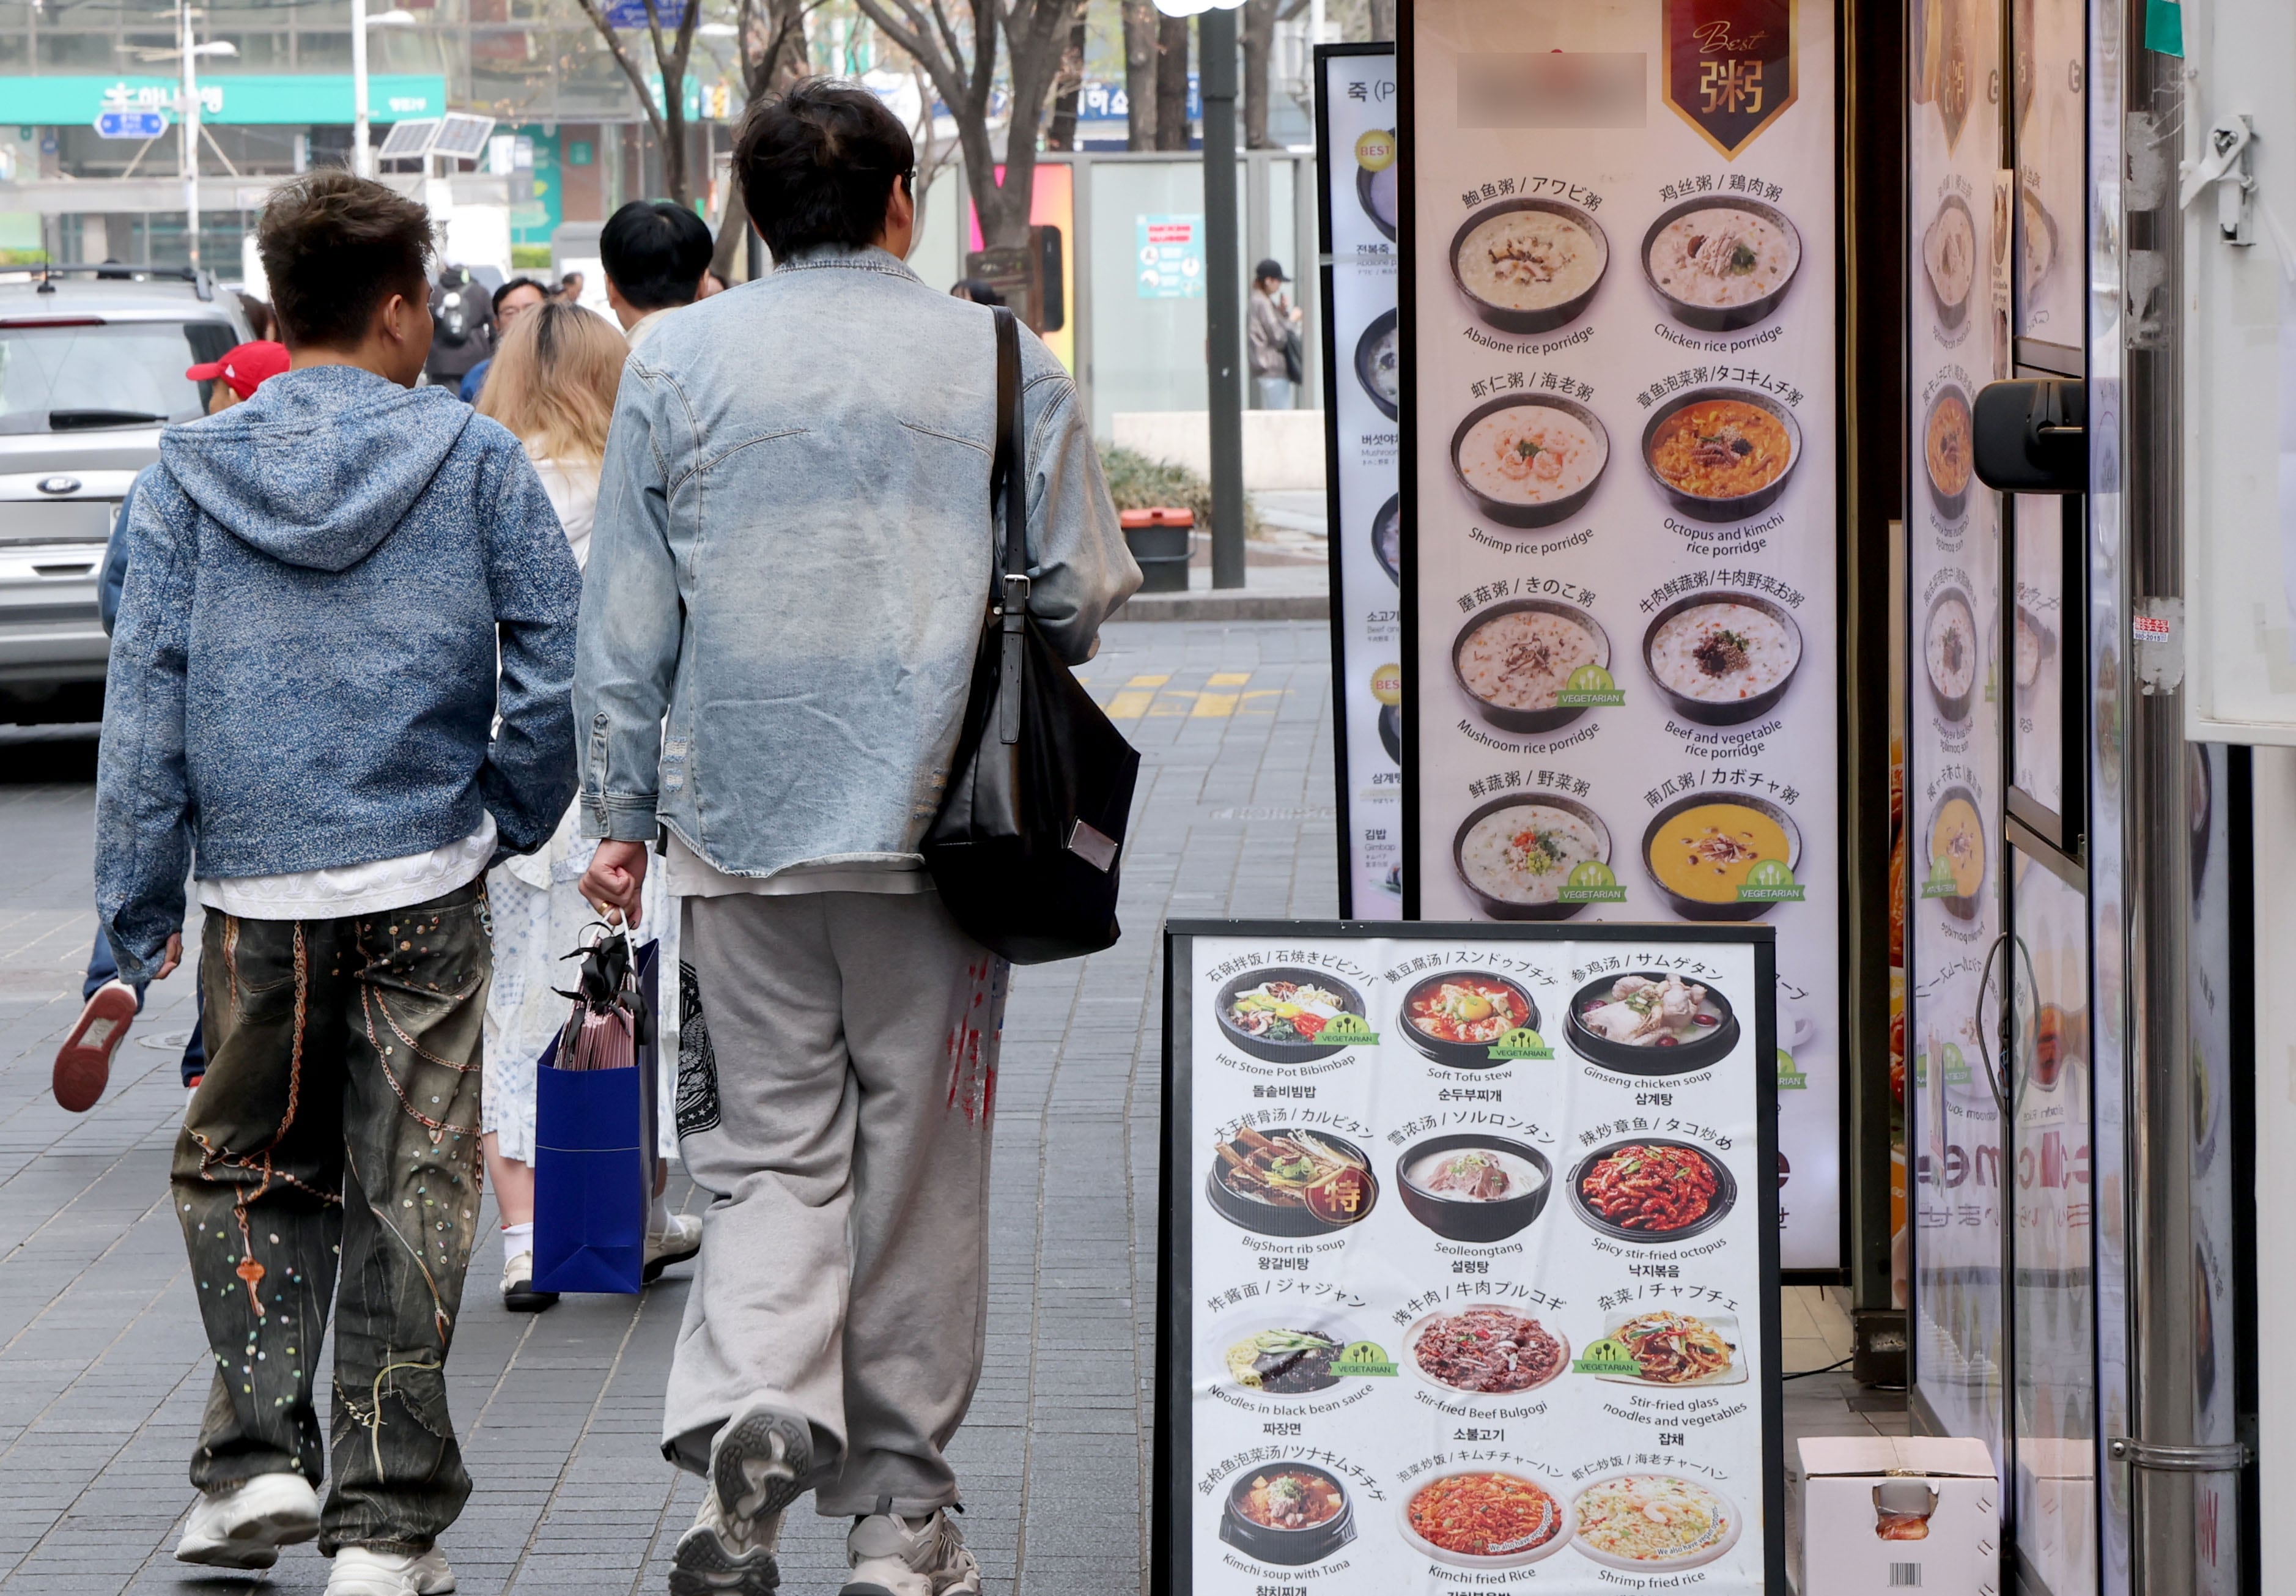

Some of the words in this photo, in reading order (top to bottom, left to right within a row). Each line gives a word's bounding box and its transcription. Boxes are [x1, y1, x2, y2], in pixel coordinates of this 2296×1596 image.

[1692, 21, 1769, 53] Best
[1348, 81, 1367, 102] 죽
[1700, 59, 1762, 113] 粥
[1360, 146, 1391, 156] BEST
[1532, 177, 1602, 211] アワビ粥
[1659, 174, 1712, 202] 鸡丝粥
[1356, 243, 1389, 254] 전복죽
[1463, 327, 1513, 353] Abalone
[1517, 342, 1540, 354] rice
[1543, 325, 1594, 355] porridge
[1655, 323, 1700, 350] Chicken
[1704, 340, 1727, 351] rice
[1730, 325, 1783, 353] porridge
[1471, 372, 1524, 398] 虾仁粥
[1540, 372, 1594, 402] 海老粥
[1664, 518, 1714, 541] Octopus
[1718, 528, 1741, 541] and
[1744, 513, 1785, 537] kimchi
[1469, 528, 1512, 553] Shrimp
[1516, 542, 1538, 553] rice
[1541, 528, 1594, 555] porridge
[1686, 542, 1709, 555] rice
[1713, 539, 1766, 558] porridge
[1457, 580, 1509, 613] 蘑菇粥
[1526, 577, 1596, 608] きのこ粥
[1457, 719, 1519, 753] Mushroom
[1524, 742, 1546, 753] rice
[1549, 722, 1600, 754] porridge
[1665, 720, 1693, 740] Beef
[1695, 733, 1718, 744] and
[1722, 720, 1782, 747] vegetable
[1685, 743, 1707, 757] rice
[1711, 743, 1765, 760] porridge
[1469, 770, 1521, 799] 鲜蔬粥
[1537, 770, 1591, 797] 野菜粥
[1644, 772, 1695, 808] 南瓜粥
[1712, 768, 1800, 805] カボチャ粥
[1365, 829, 1386, 840] 김밥
[1205, 951, 1263, 983] 石锅拌饭
[1384, 954, 1441, 983] 嫩豆腐汤
[1571, 956, 1620, 983] 参鸡汤
[1636, 954, 1723, 981] サムゲタン
[1216, 1053, 1237, 1068] Hot
[1239, 1062, 1273, 1076] Stone
[1277, 1068, 1297, 1076] Pot
[1301, 1054, 1356, 1074] Bibimbap
[1427, 1068, 1451, 1079] Soft
[1456, 1073, 1481, 1081] Tofu
[1485, 1070, 1512, 1081] stew
[1584, 1066, 1631, 1088] Ginseng
[1634, 1079, 1680, 1088] chicken
[1684, 1071, 1711, 1085] soup
[1253, 1085, 1316, 1098] 돌솥비빔밥
[1438, 1088, 1502, 1102] 순두부찌개
[1635, 1093, 1673, 1106] 삼계탕
[1302, 1108, 1374, 1139] カルビタン
[1387, 1115, 1437, 1146] 雪浓汤
[1453, 1110, 1555, 1143] ソルロンタン
[1579, 1117, 1648, 1147] 辣炒章鱼
[1667, 1118, 1732, 1150] タコ炒め
[1324, 1180, 1360, 1213] 特
[1297, 1244, 1313, 1253] rib
[1316, 1239, 1345, 1252] soup
[1434, 1242, 1523, 1258] Seolleongtang
[1591, 1238, 1623, 1257] Spicy
[1625, 1250, 1677, 1260] stir-fried
[1680, 1238, 1727, 1258] octopus
[1258, 1257, 1309, 1270] 왕갈비탕
[1452, 1260, 1489, 1273] 설렁탕
[1630, 1265, 1680, 1278] 낙지볶음
[1207, 1282, 1260, 1312] 炸酱面
[1277, 1278, 1366, 1307] ジャジャン
[1392, 1289, 1441, 1326] 烤牛肉
[1456, 1280, 1567, 1311] 牛肉プルコギ
[1597, 1288, 1633, 1311] 杂菜
[1650, 1283, 1738, 1312] チャプチェ
[1208, 1384, 1259, 1411] Noodles
[1258, 1403, 1269, 1414] in
[1274, 1404, 1306, 1416] black
[1309, 1401, 1340, 1413] bean
[1342, 1383, 1374, 1406] sauce
[1414, 1391, 1466, 1416] Stir-fried
[1470, 1408, 1497, 1419] Beef
[1500, 1400, 1548, 1419] Bulgogi
[1630, 1395, 1685, 1410] Stir-fried
[1688, 1397, 1719, 1411] glass
[1603, 1403, 1652, 1425] noodles
[1654, 1416, 1678, 1426] and
[1682, 1402, 1747, 1427] vegetables
[1263, 1423, 1301, 1436] 짜장면
[1453, 1428, 1505, 1441] 소불고기
[1659, 1433, 1684, 1446] 잡채
[1458, 1450, 1564, 1479] キムチチャーハン
[1635, 1453, 1728, 1480] 海老チャーハン
[1515, 1537, 1530, 1546] have
[1530, 1525, 1546, 1540] vegan
[1683, 1542, 1698, 1551] have
[1698, 1531, 1713, 1543] vegan
[1223, 1553, 1260, 1576] Kimchi
[1263, 1570, 1291, 1582] soup
[1294, 1568, 1320, 1579] with
[1321, 1560, 1350, 1576] Tuna
[1428, 1565, 1472, 1584] Kimchi
[1476, 1572, 1505, 1584] fried
[1510, 1568, 1536, 1581] Rice
[1598, 1570, 1645, 1589] Shrimp
[1649, 1578, 1679, 1587] fried
[1683, 1572, 1705, 1585] rice
